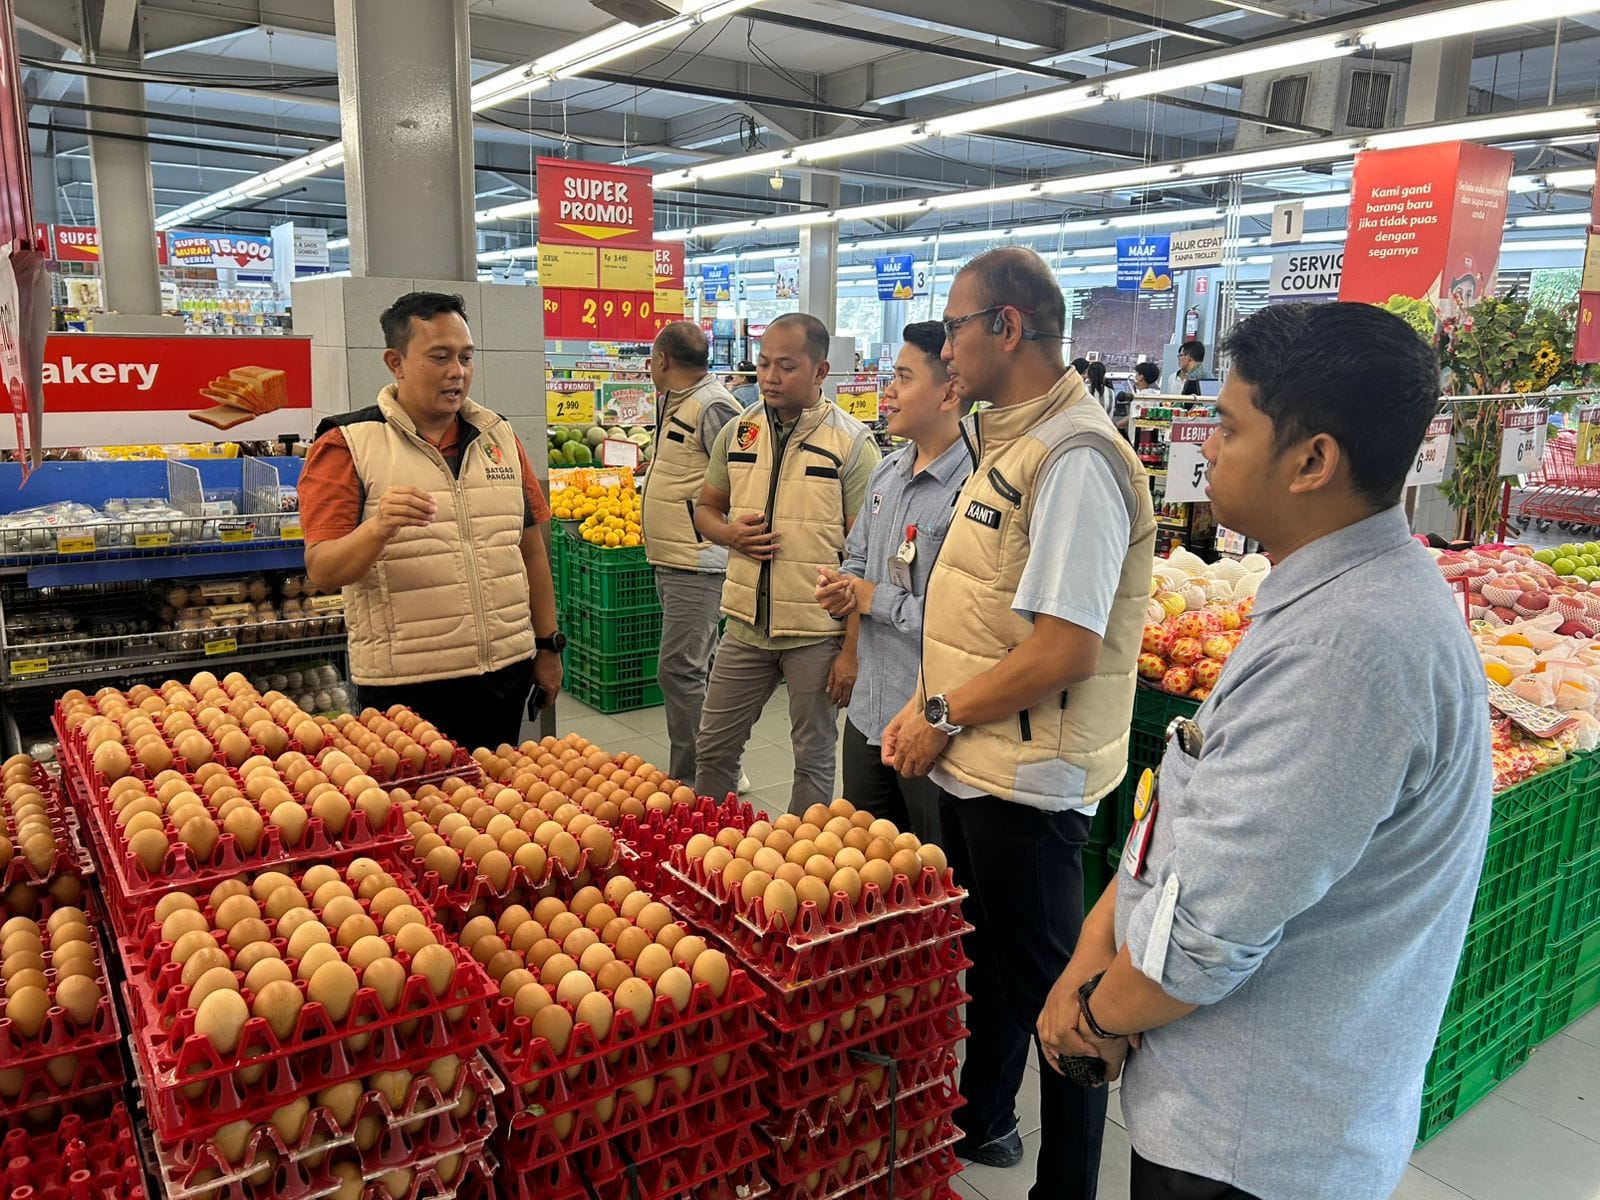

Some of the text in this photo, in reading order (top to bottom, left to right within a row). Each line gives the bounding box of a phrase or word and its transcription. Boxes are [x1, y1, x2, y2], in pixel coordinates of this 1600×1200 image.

[564, 176, 629, 204] SUPER
[1371, 182, 1432, 198] Kami ganti
[560, 200, 633, 225] PROMO!
[1366, 199, 1433, 213] barang baru
[1283, 209, 1293, 234] 1
[1357, 215, 1437, 230] jika tidak puas
[174, 239, 207, 248] SUPER
[1375, 231, 1416, 243] dengan
[175, 246, 211, 257] MURAH
[209, 239, 271, 258] 15.000
[1128, 245, 1156, 257] MAAF
[1171, 237, 1223, 252] JALUR CEPAT
[1175, 251, 1217, 261] TANPA TROLLEY
[1368, 247, 1419, 259] segarnya
[917, 271, 925, 288] 3
[544, 299, 559, 313] Rp
[564, 383, 591, 391] PROMO!
[1180, 427, 1207, 440] LEBIH
[967, 503, 994, 524] KANIT
